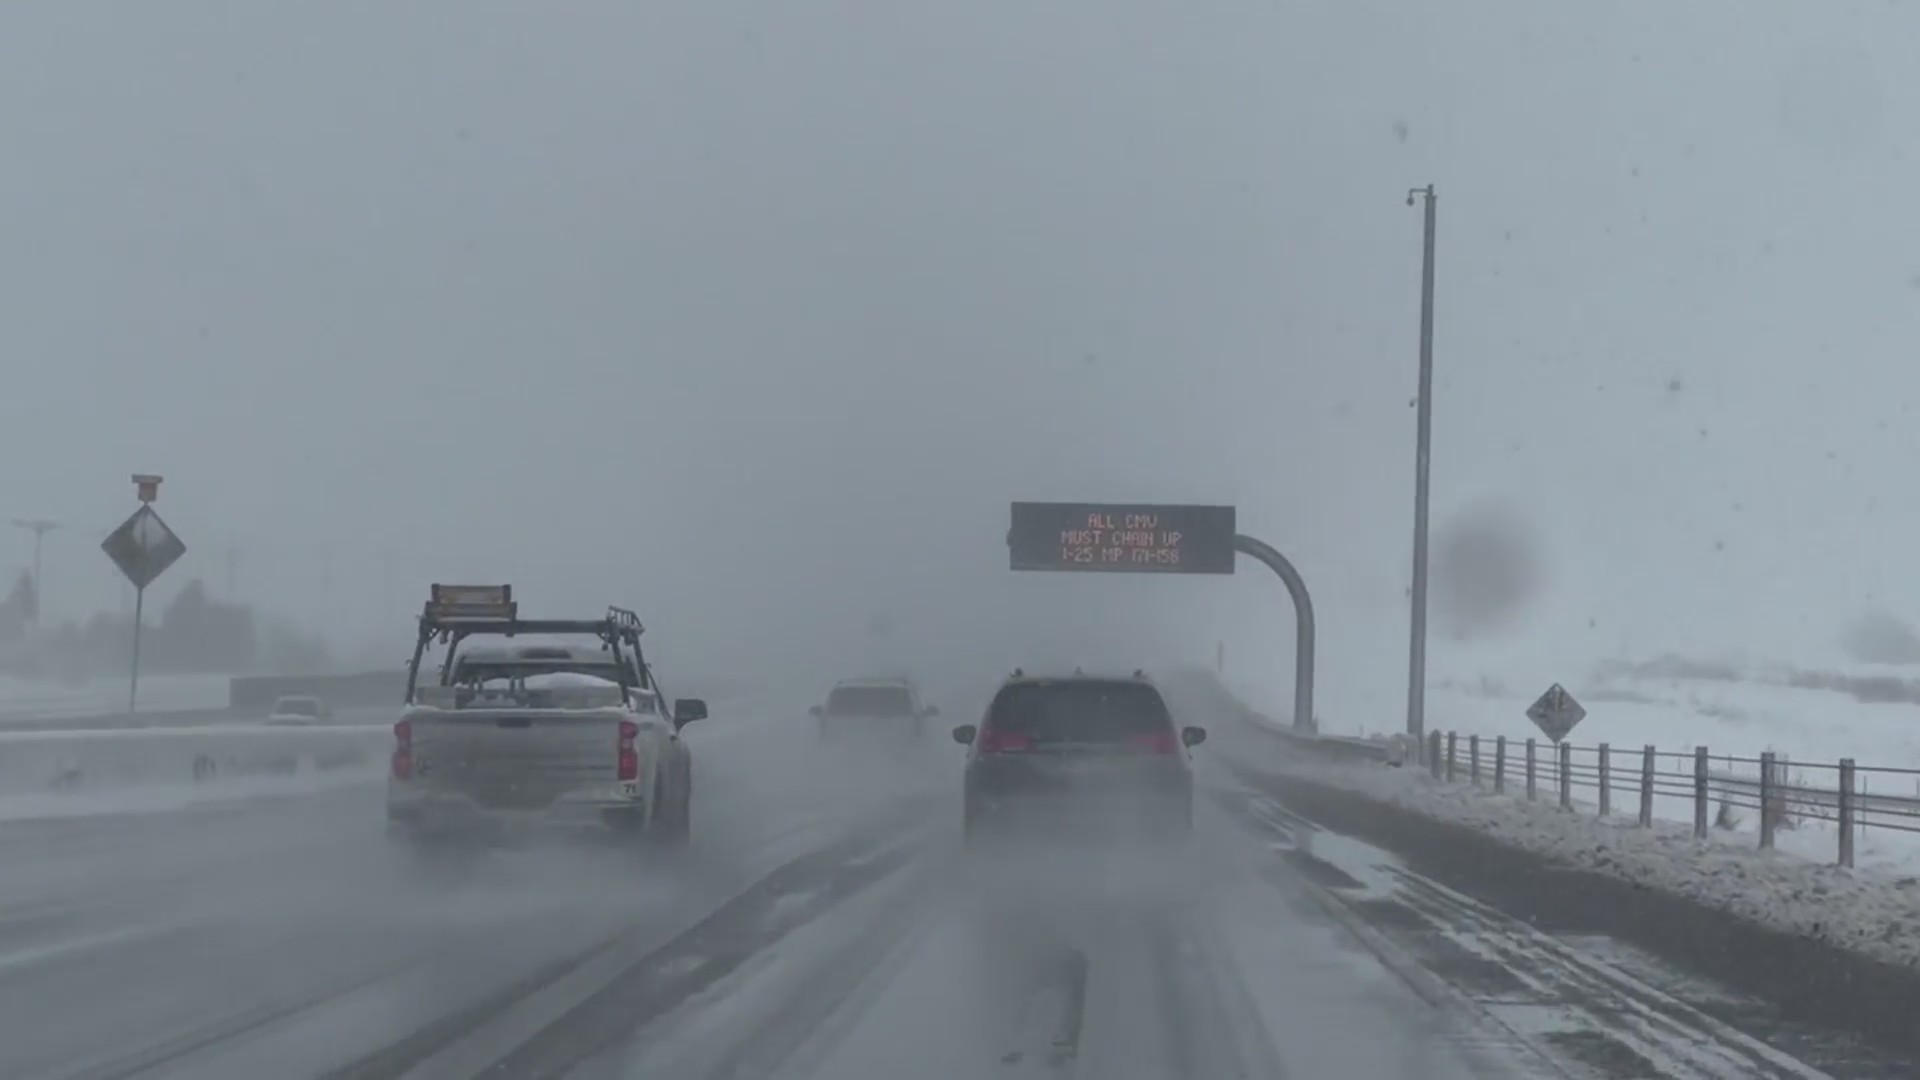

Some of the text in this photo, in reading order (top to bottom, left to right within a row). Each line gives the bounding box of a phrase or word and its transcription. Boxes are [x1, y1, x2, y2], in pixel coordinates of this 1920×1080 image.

[1087, 513, 1158, 529] ALL CMV
[1061, 530, 1182, 546] MUST CHAIN UP
[1102, 548, 1123, 562] MP
